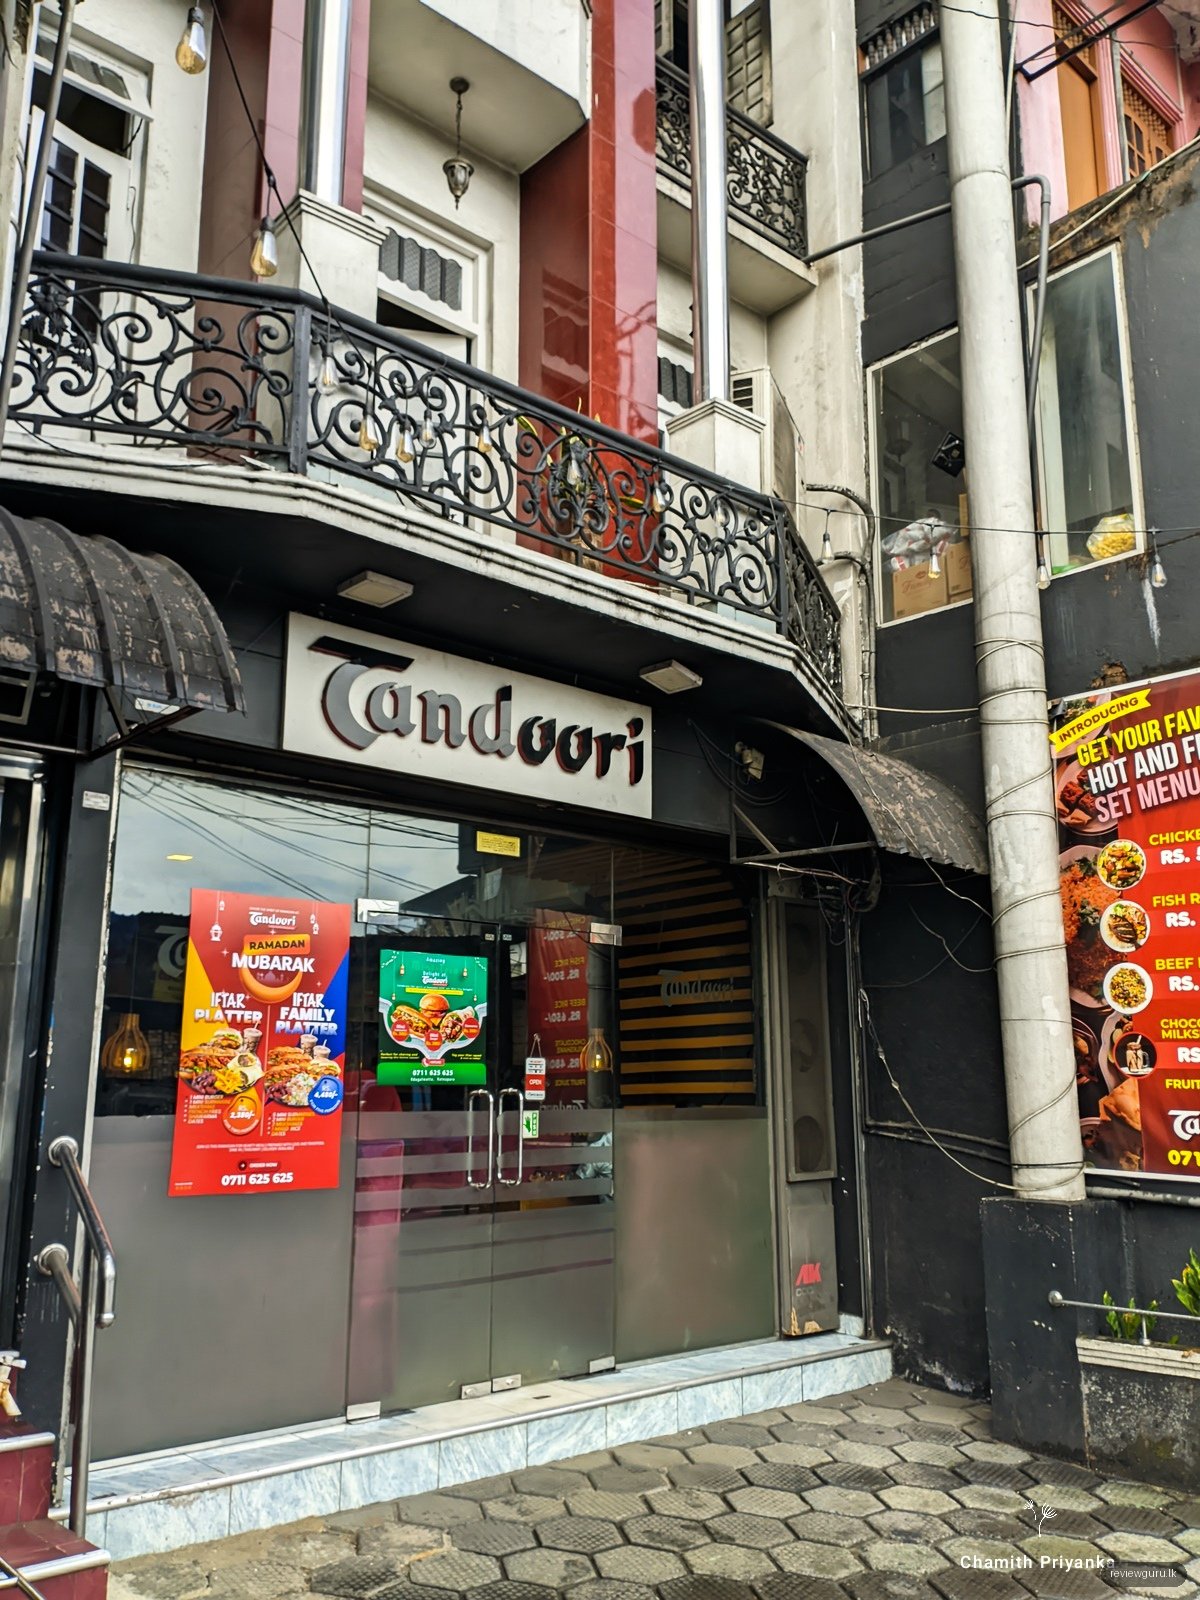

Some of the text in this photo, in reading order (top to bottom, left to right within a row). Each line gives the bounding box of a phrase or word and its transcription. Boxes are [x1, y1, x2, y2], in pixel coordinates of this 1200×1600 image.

[307, 635, 645, 786] Tandoori
[1059, 697, 1139, 743] INTRODUCING
[1076, 736, 1110, 768] GET
[1111, 718, 1163, 755] YOUR
[1087, 757, 1129, 795] HOT
[1134, 741, 1179, 780] AND
[1094, 766, 1200, 825] SET MENU
[1160, 848, 1191, 865] RS.
[1152, 894, 1186, 907] FISH
[248, 911, 296, 926] Tandoori
[1165, 911, 1196, 928] RS.
[250, 939, 305, 950] RAMADAN
[232, 953, 315, 973] MUBARAK
[1155, 957, 1194, 971] BEEF
[1168, 975, 1200, 992] RS.
[211, 992, 246, 1009] IFTAR
[292, 992, 324, 1008] IFTAR
[194, 1009, 263, 1023] PLATTER
[280, 1007, 335, 1021] FAMILY
[275, 1020, 338, 1036] PLATTER
[1165, 1079, 1200, 1089] FRUIT
[221, 1172, 294, 1187] 0711 625 625
